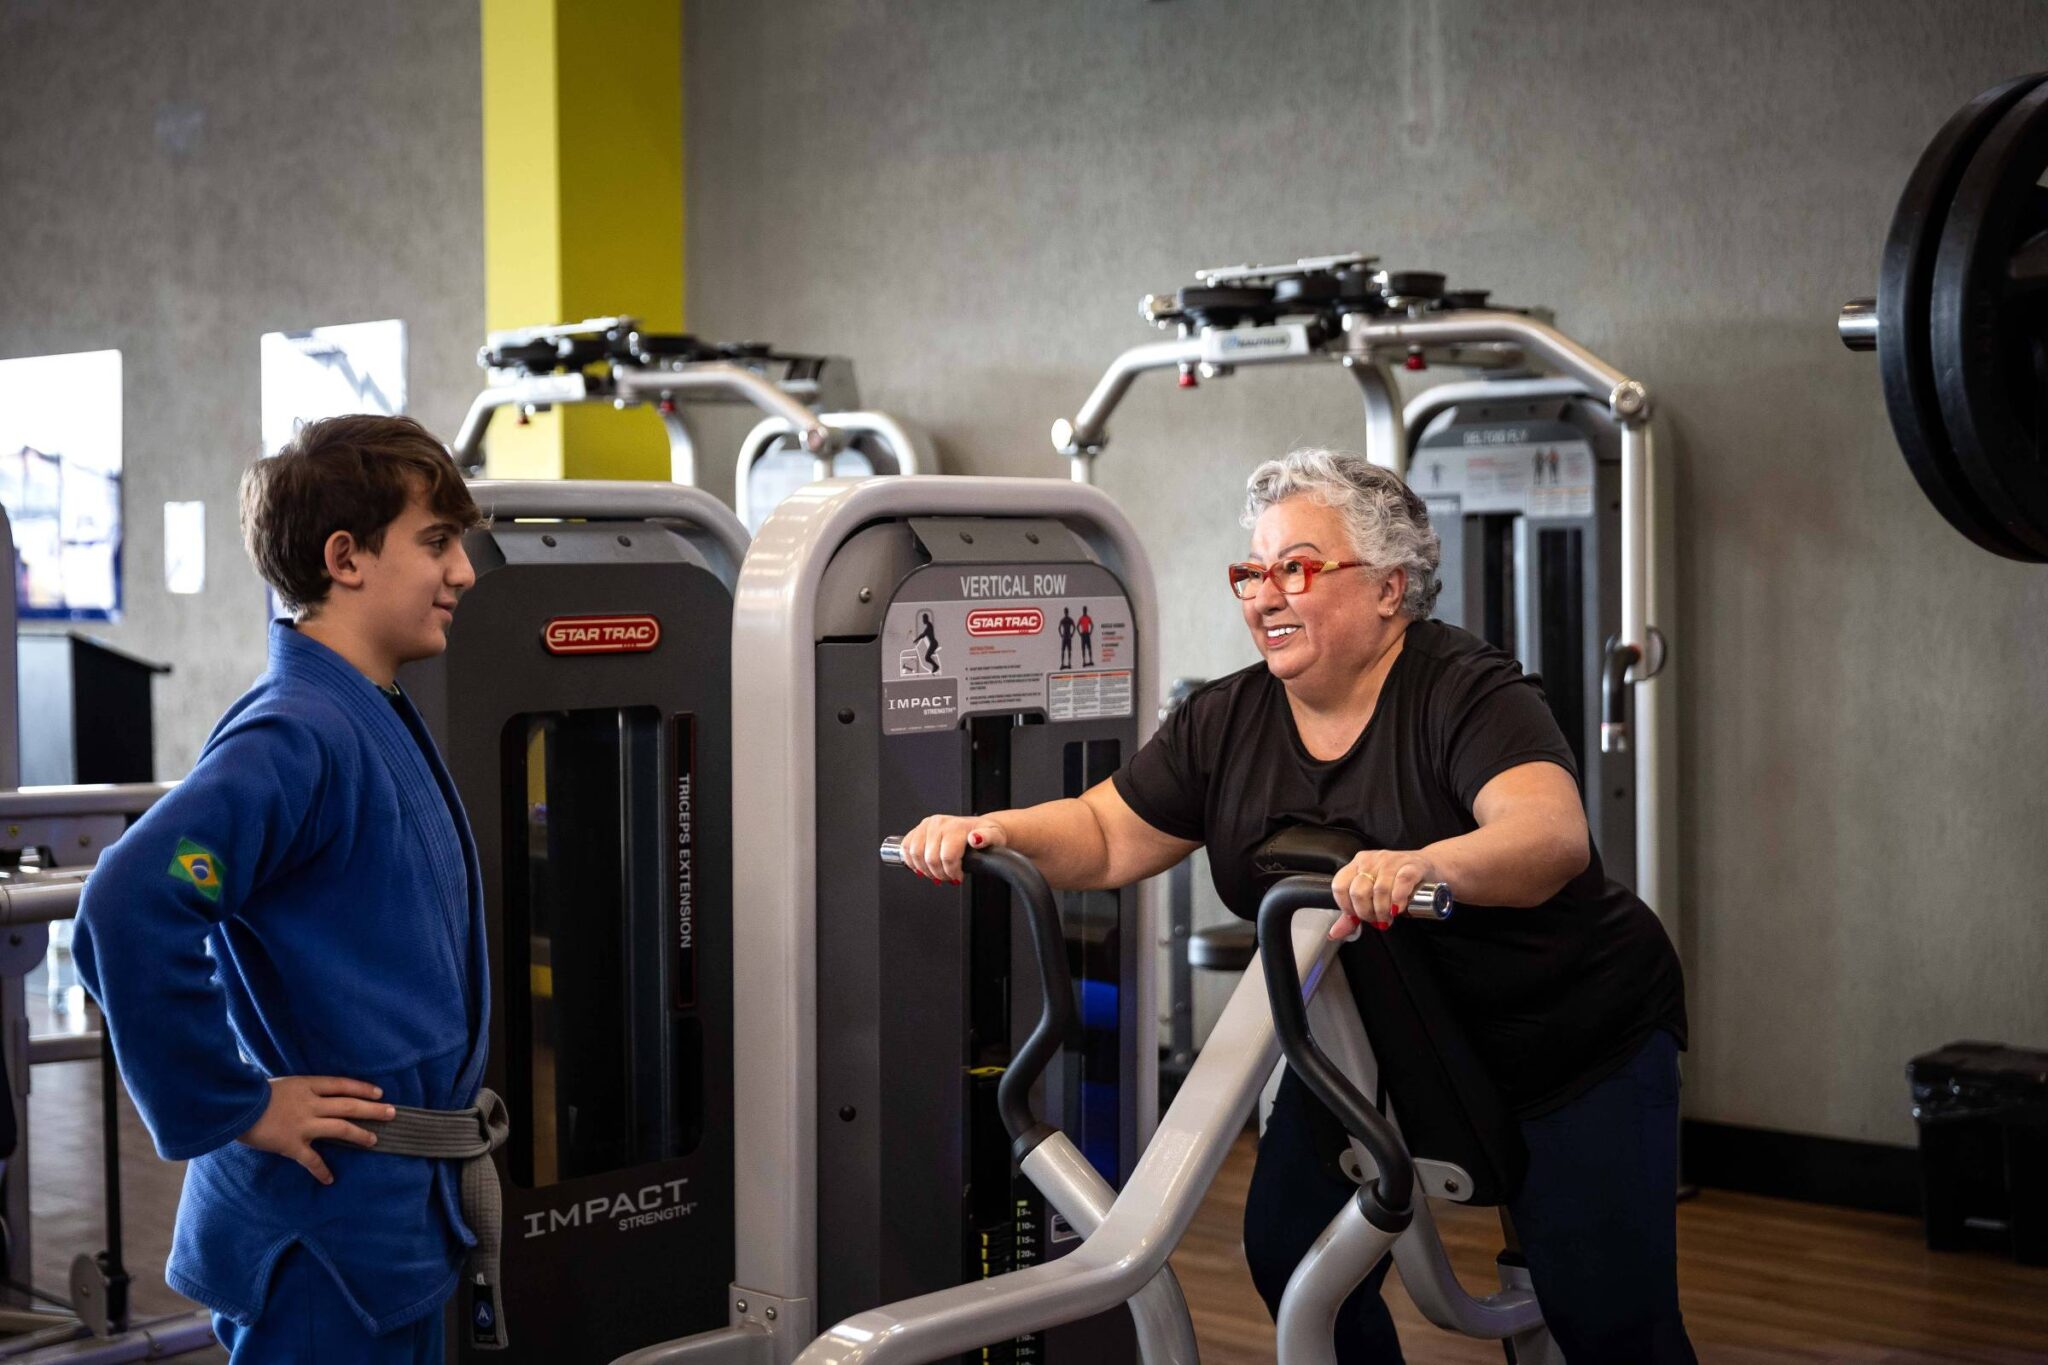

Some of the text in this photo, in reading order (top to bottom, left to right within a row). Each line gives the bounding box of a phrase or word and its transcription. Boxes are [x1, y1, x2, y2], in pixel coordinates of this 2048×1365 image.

[960, 574, 1066, 597] VERTICAL ROW
[972, 615, 1038, 628] STAR TRAC
[553, 625, 650, 642] STAR TRAC
[888, 695, 952, 710] IMPACT
[679, 772, 692, 949] TRICEPS EXTENSION
[523, 1177, 689, 1239] IMPACT
[618, 1204, 692, 1231] STRENGTH
